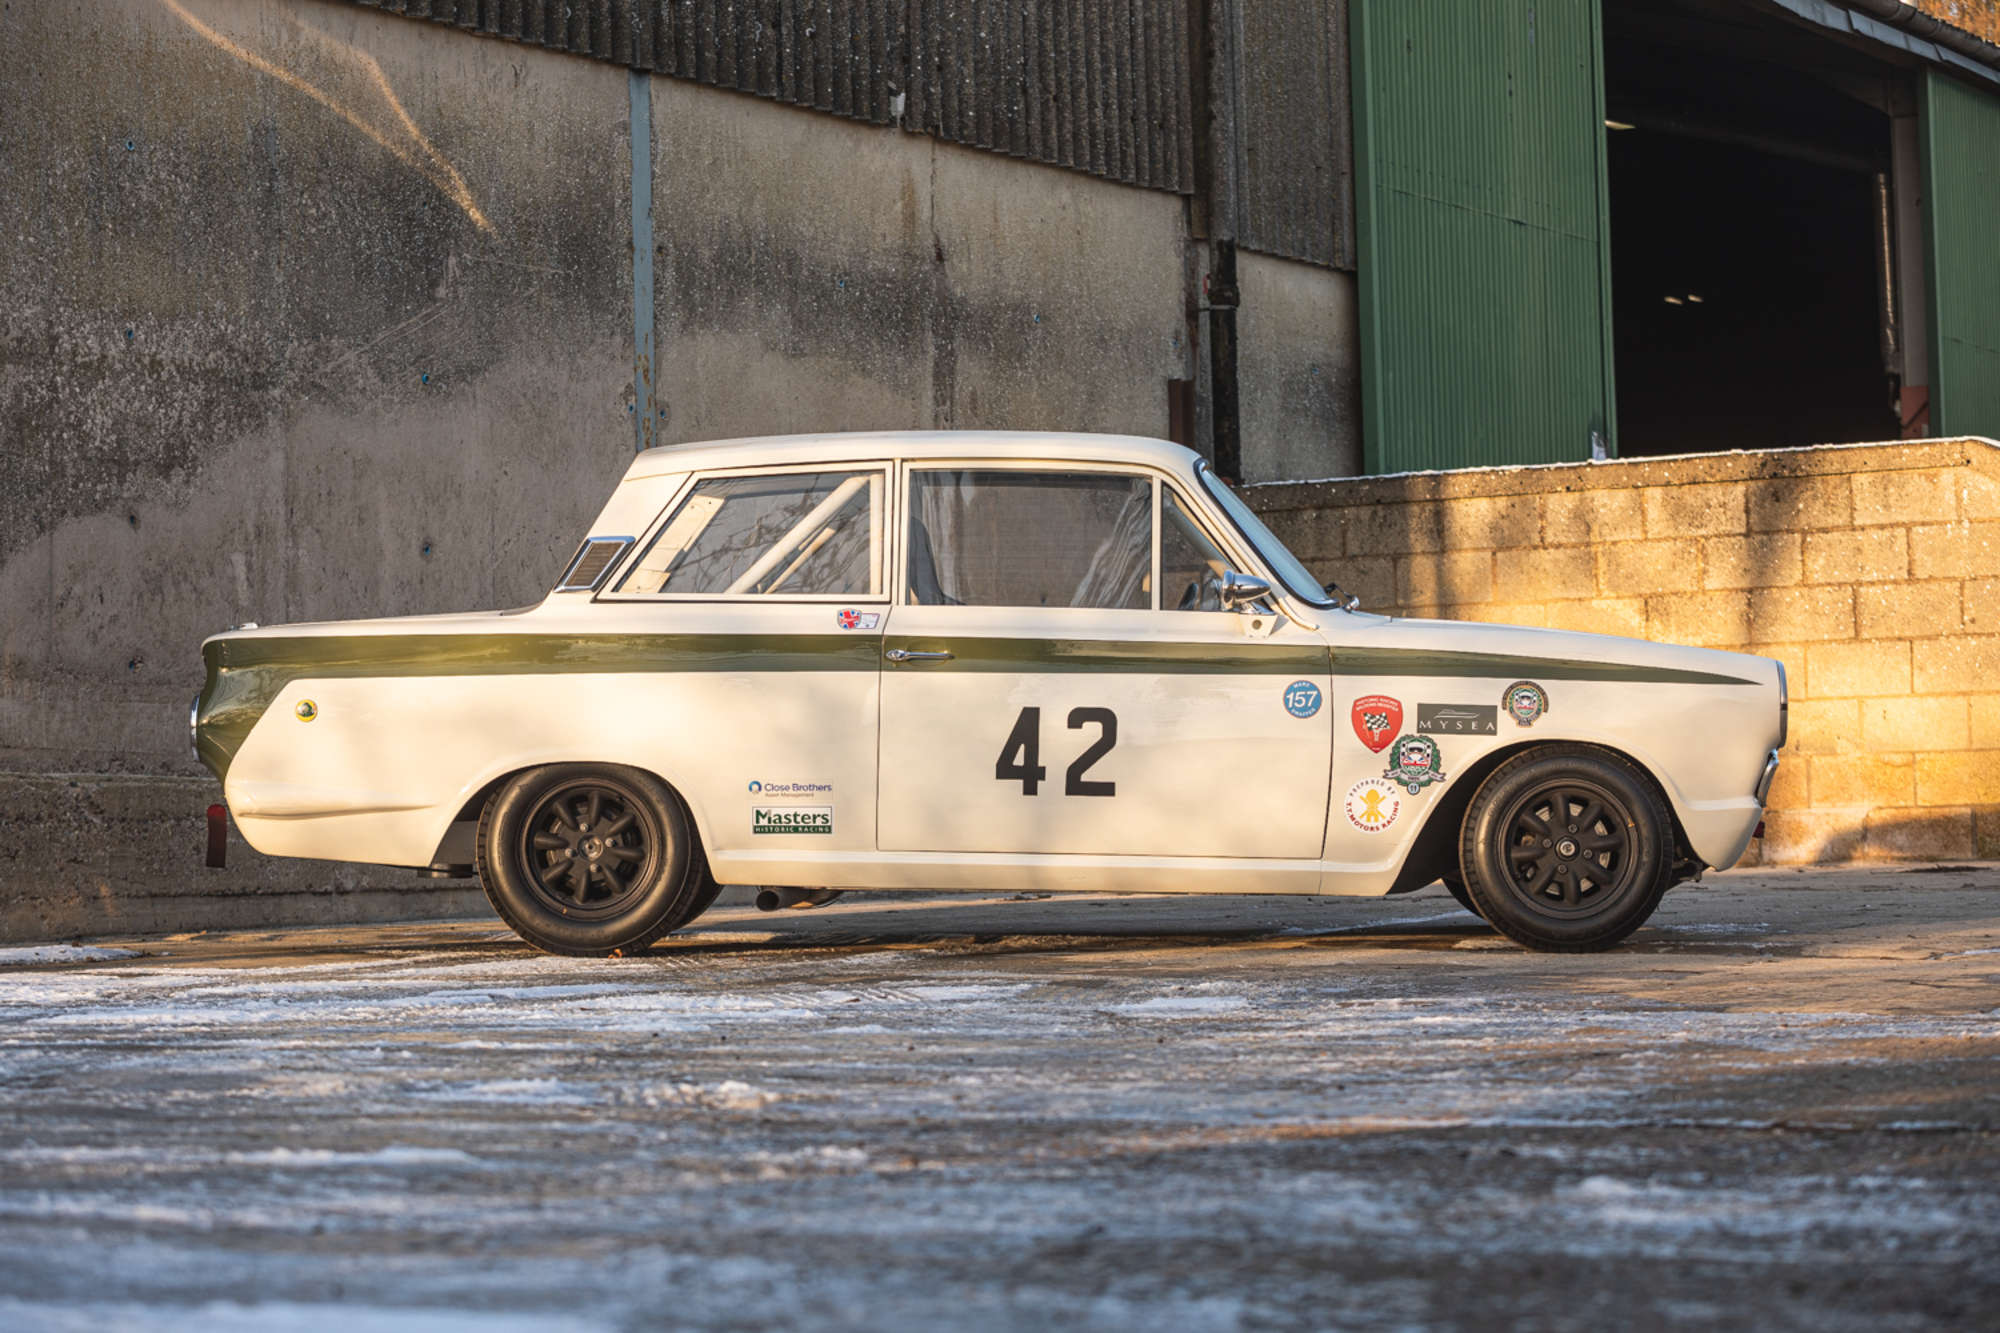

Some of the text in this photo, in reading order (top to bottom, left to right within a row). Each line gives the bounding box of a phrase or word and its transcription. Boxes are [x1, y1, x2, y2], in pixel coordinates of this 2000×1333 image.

[1286, 690, 1318, 708] 157
[1419, 720, 1495, 731] MYSEA
[996, 706, 1117, 797] 42
[764, 783, 832, 792] Close Brothers
[755, 809, 830, 825] Masters
